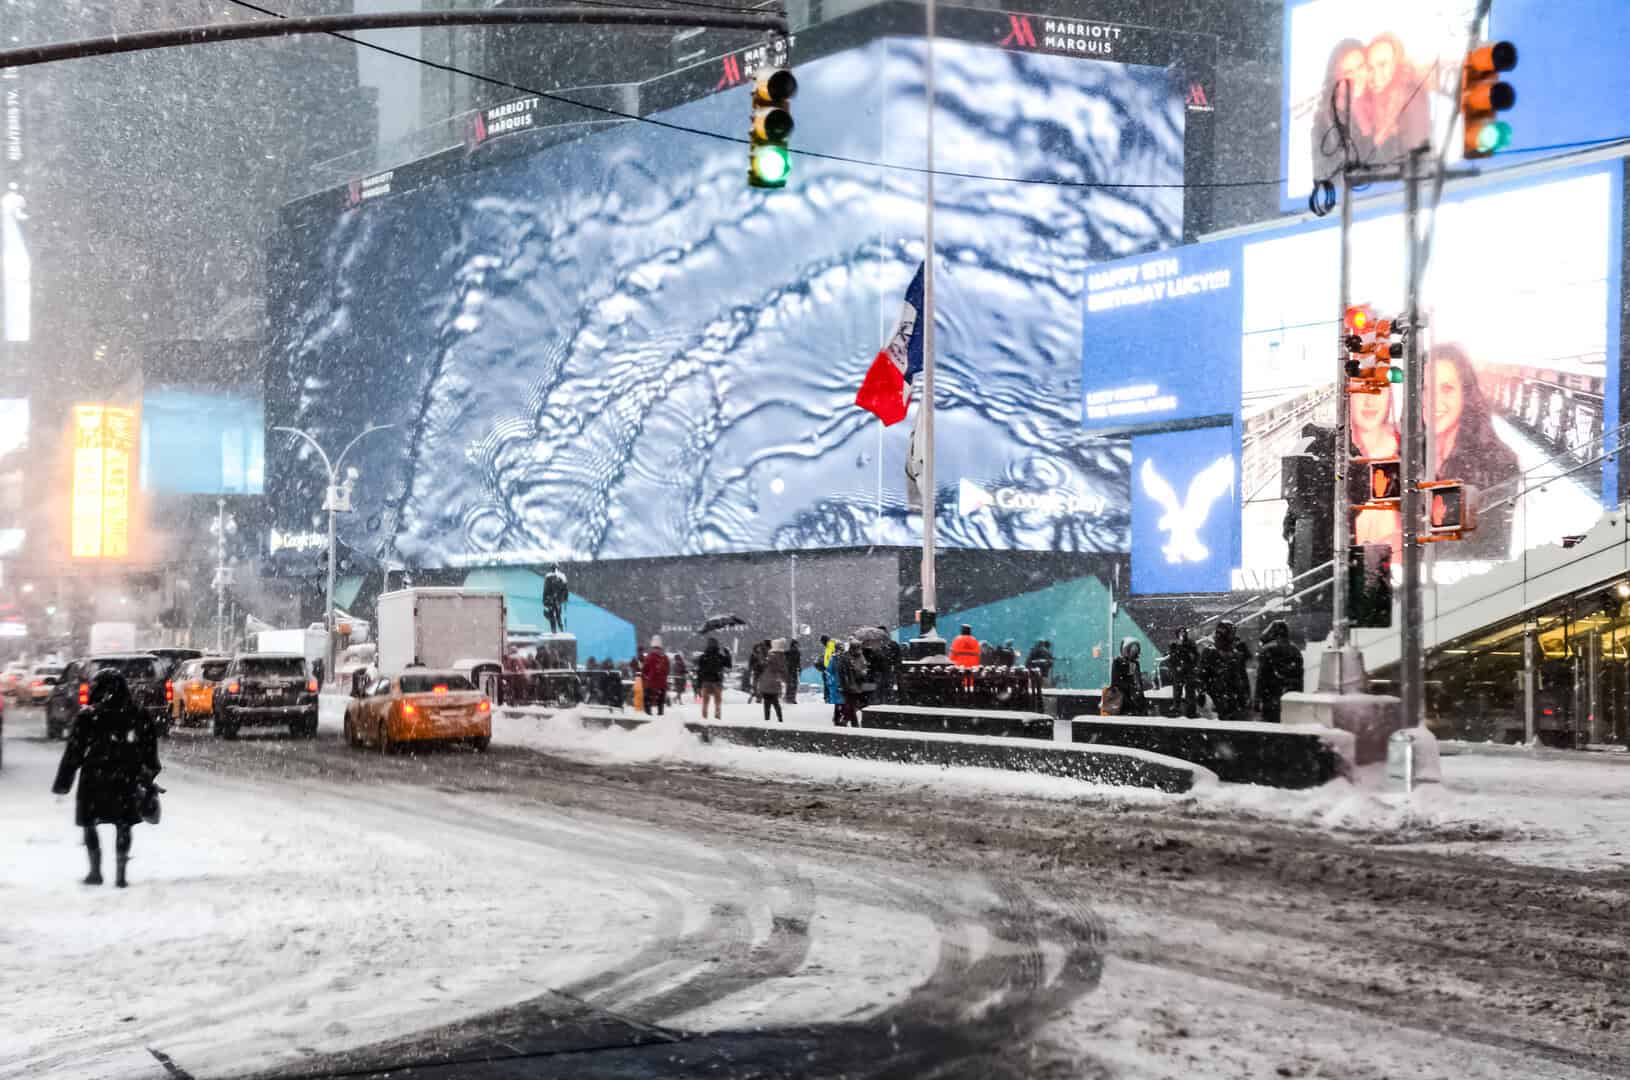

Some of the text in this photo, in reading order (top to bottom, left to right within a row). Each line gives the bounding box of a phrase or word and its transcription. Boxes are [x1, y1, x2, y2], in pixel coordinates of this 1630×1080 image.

[1045, 21, 1121, 39] MARRIOTT
[1045, 36, 1113, 53] MARQUIS
[488, 97, 540, 120] MARRIOTT
[488, 113, 533, 135] MARQUIS
[1087, 264, 1139, 292] HAPPY
[996, 487, 1107, 518] Google play
